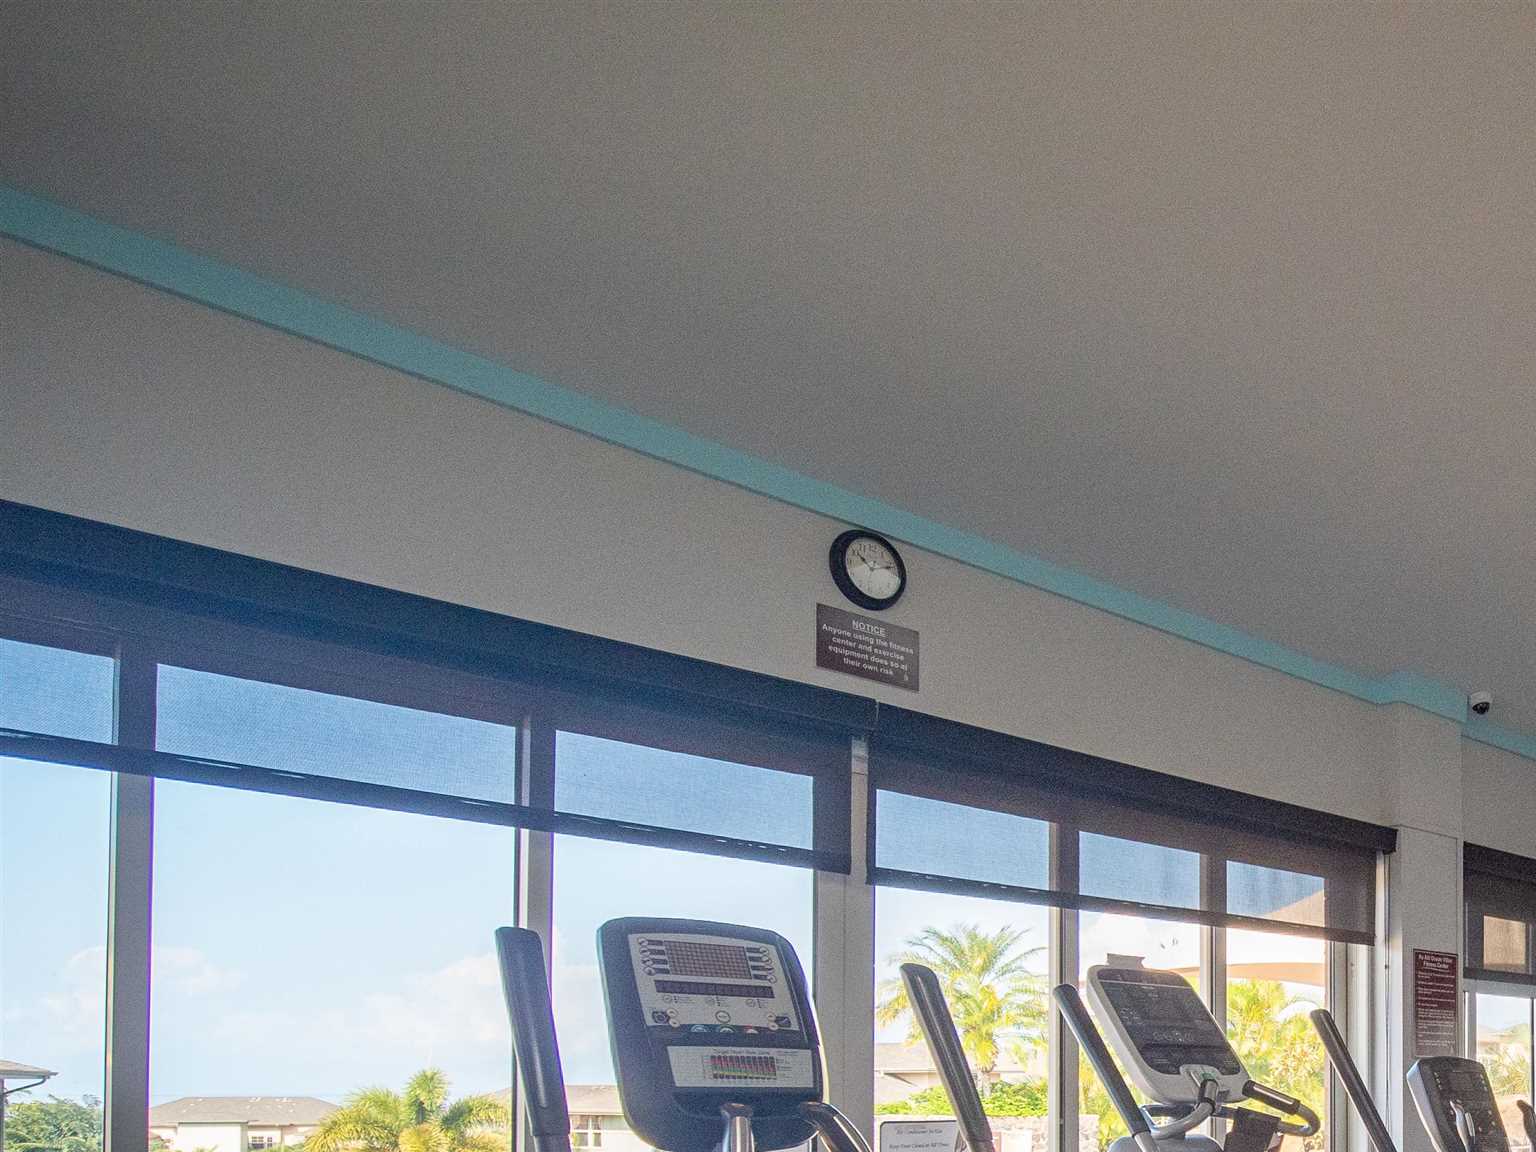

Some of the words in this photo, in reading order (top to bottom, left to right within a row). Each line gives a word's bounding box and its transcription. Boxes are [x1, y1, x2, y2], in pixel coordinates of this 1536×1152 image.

[822, 623, 851, 637] Anyone
[853, 633, 874, 644] using
[876, 638, 888, 648] the
[852, 620, 886, 636] NOTICE
[832, 637, 857, 648] center
[858, 643, 872, 652] and
[828, 645, 869, 661] equipment
